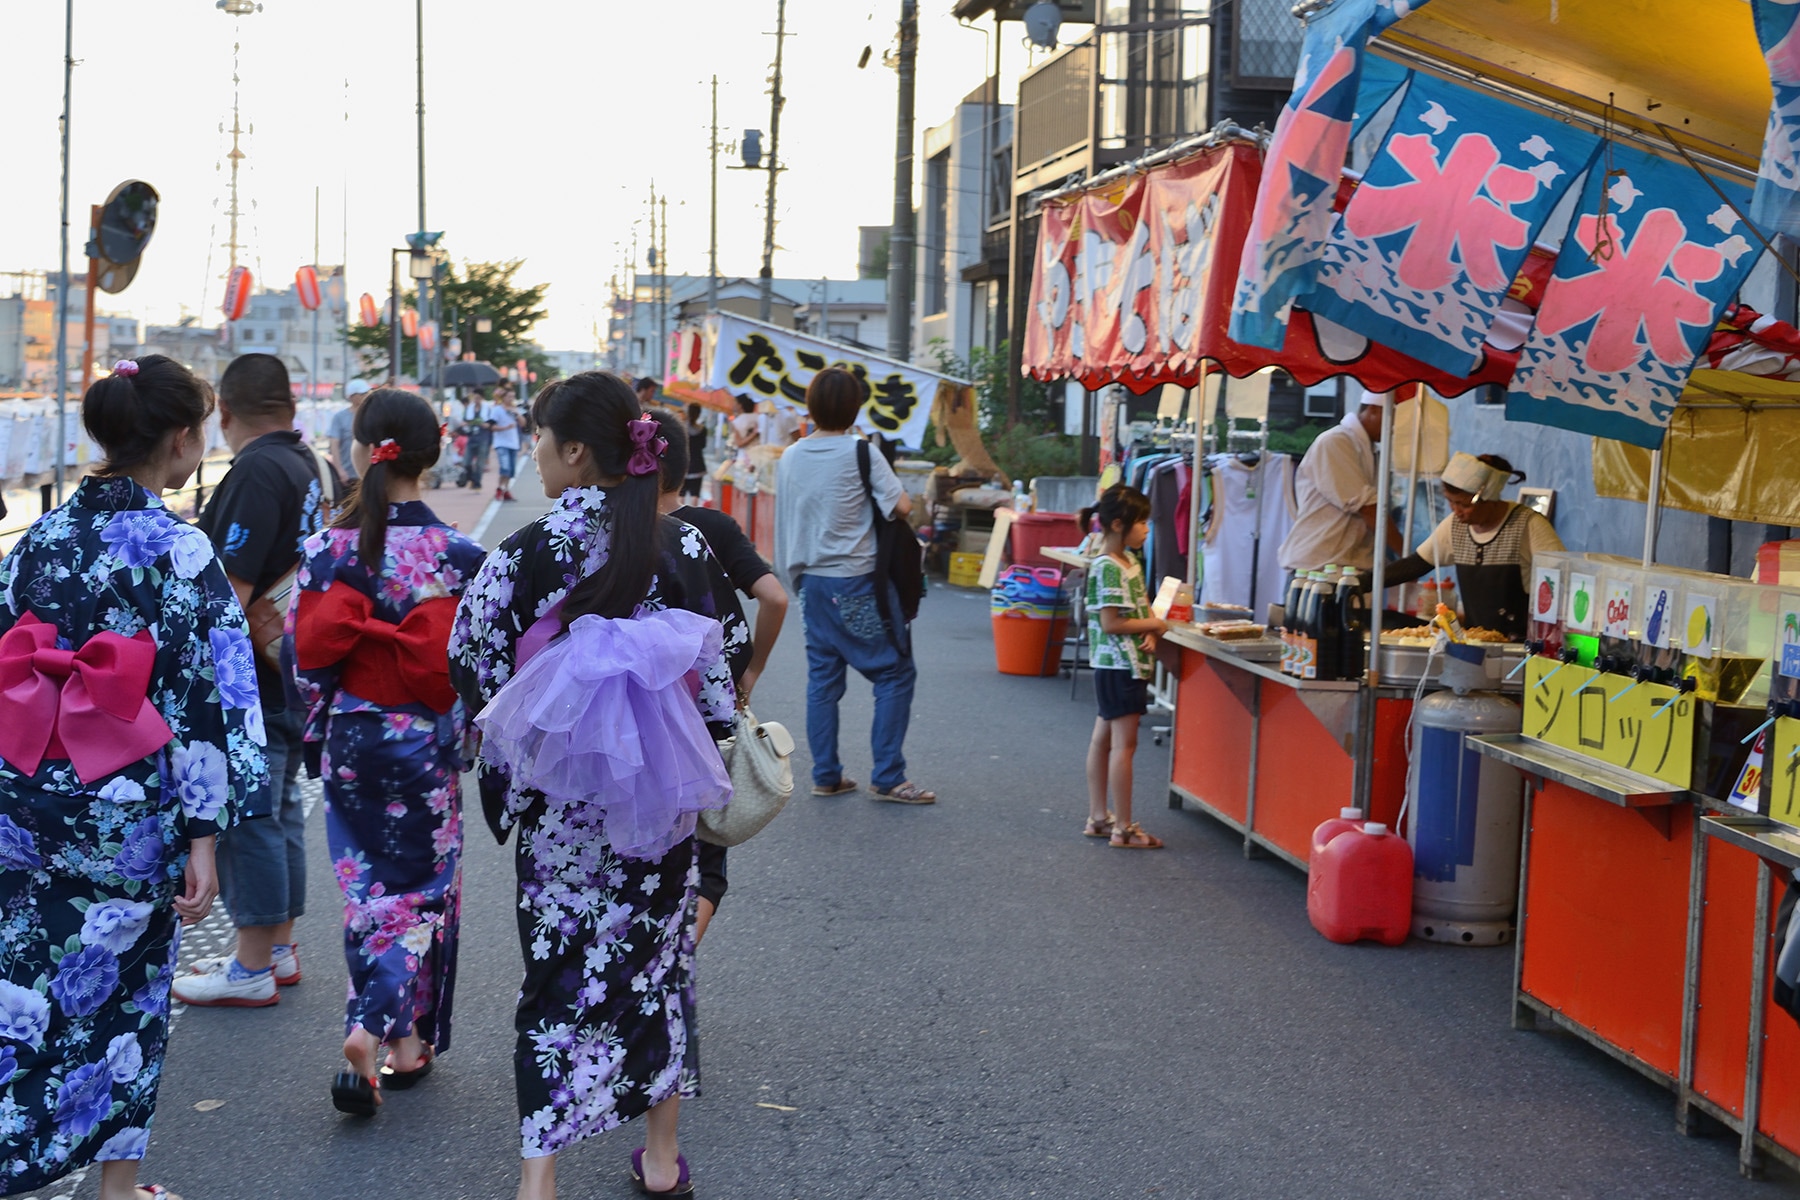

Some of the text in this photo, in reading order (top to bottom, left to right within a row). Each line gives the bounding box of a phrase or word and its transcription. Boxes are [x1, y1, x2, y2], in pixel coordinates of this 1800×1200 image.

[1343, 132, 1538, 293] 氷
[1536, 208, 1725, 374] 氷
[1534, 672, 1689, 774] シロップ
